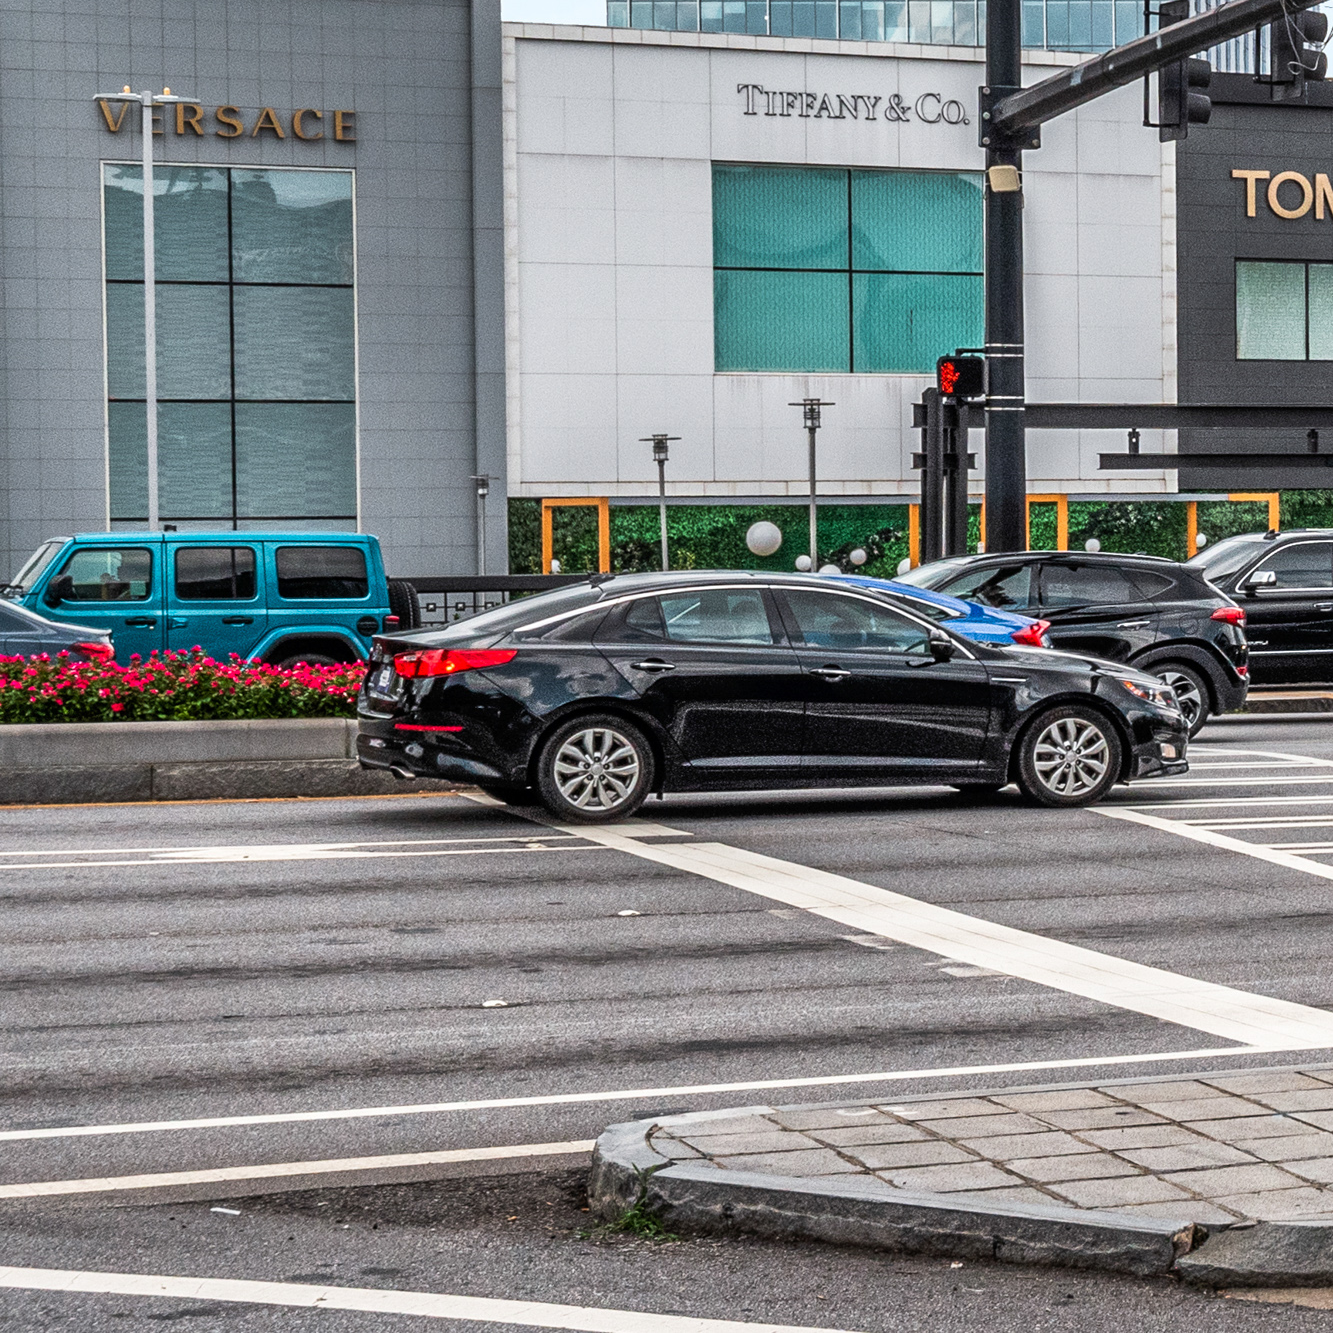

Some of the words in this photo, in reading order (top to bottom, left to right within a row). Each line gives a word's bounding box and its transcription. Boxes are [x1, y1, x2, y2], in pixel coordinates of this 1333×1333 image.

[99, 99, 356, 141] VERSACE
[737, 83, 881, 121] TIFFANY
[884, 93, 910, 122] &
